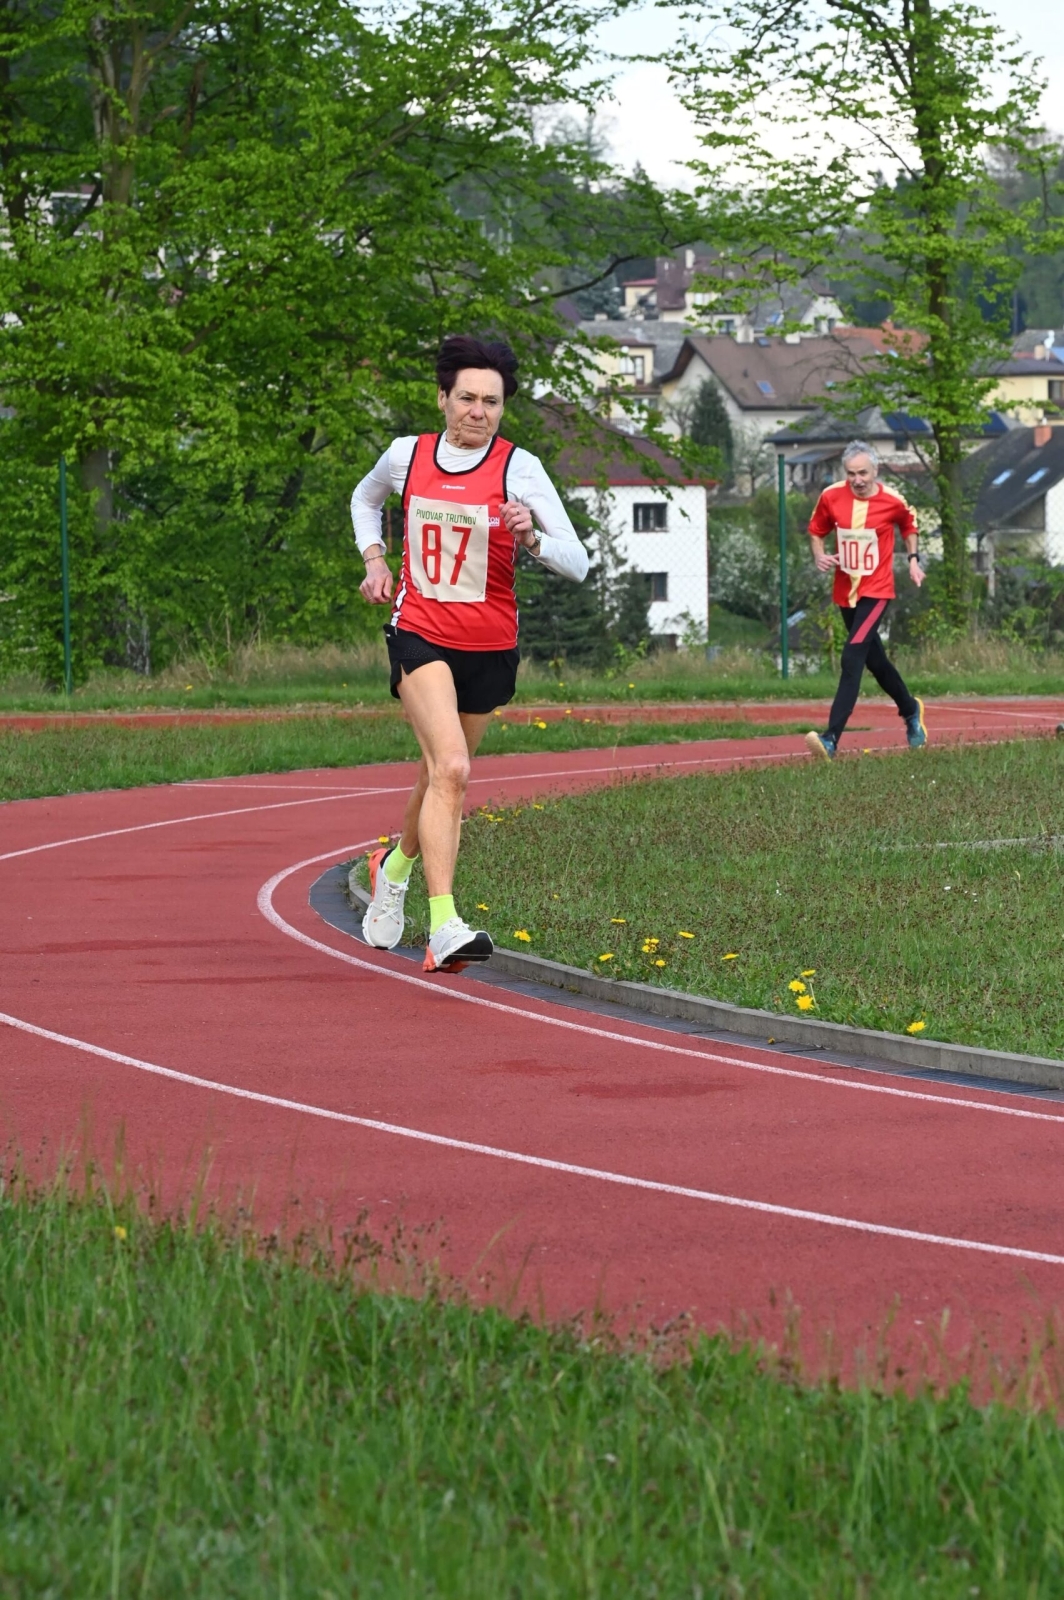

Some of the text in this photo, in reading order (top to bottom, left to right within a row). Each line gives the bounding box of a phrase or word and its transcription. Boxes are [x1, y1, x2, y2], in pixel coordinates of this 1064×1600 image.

[416, 508, 477, 525] PIVOVAR TRUTNOV
[422, 523, 472, 586] 87
[841, 541, 873, 571] 106
